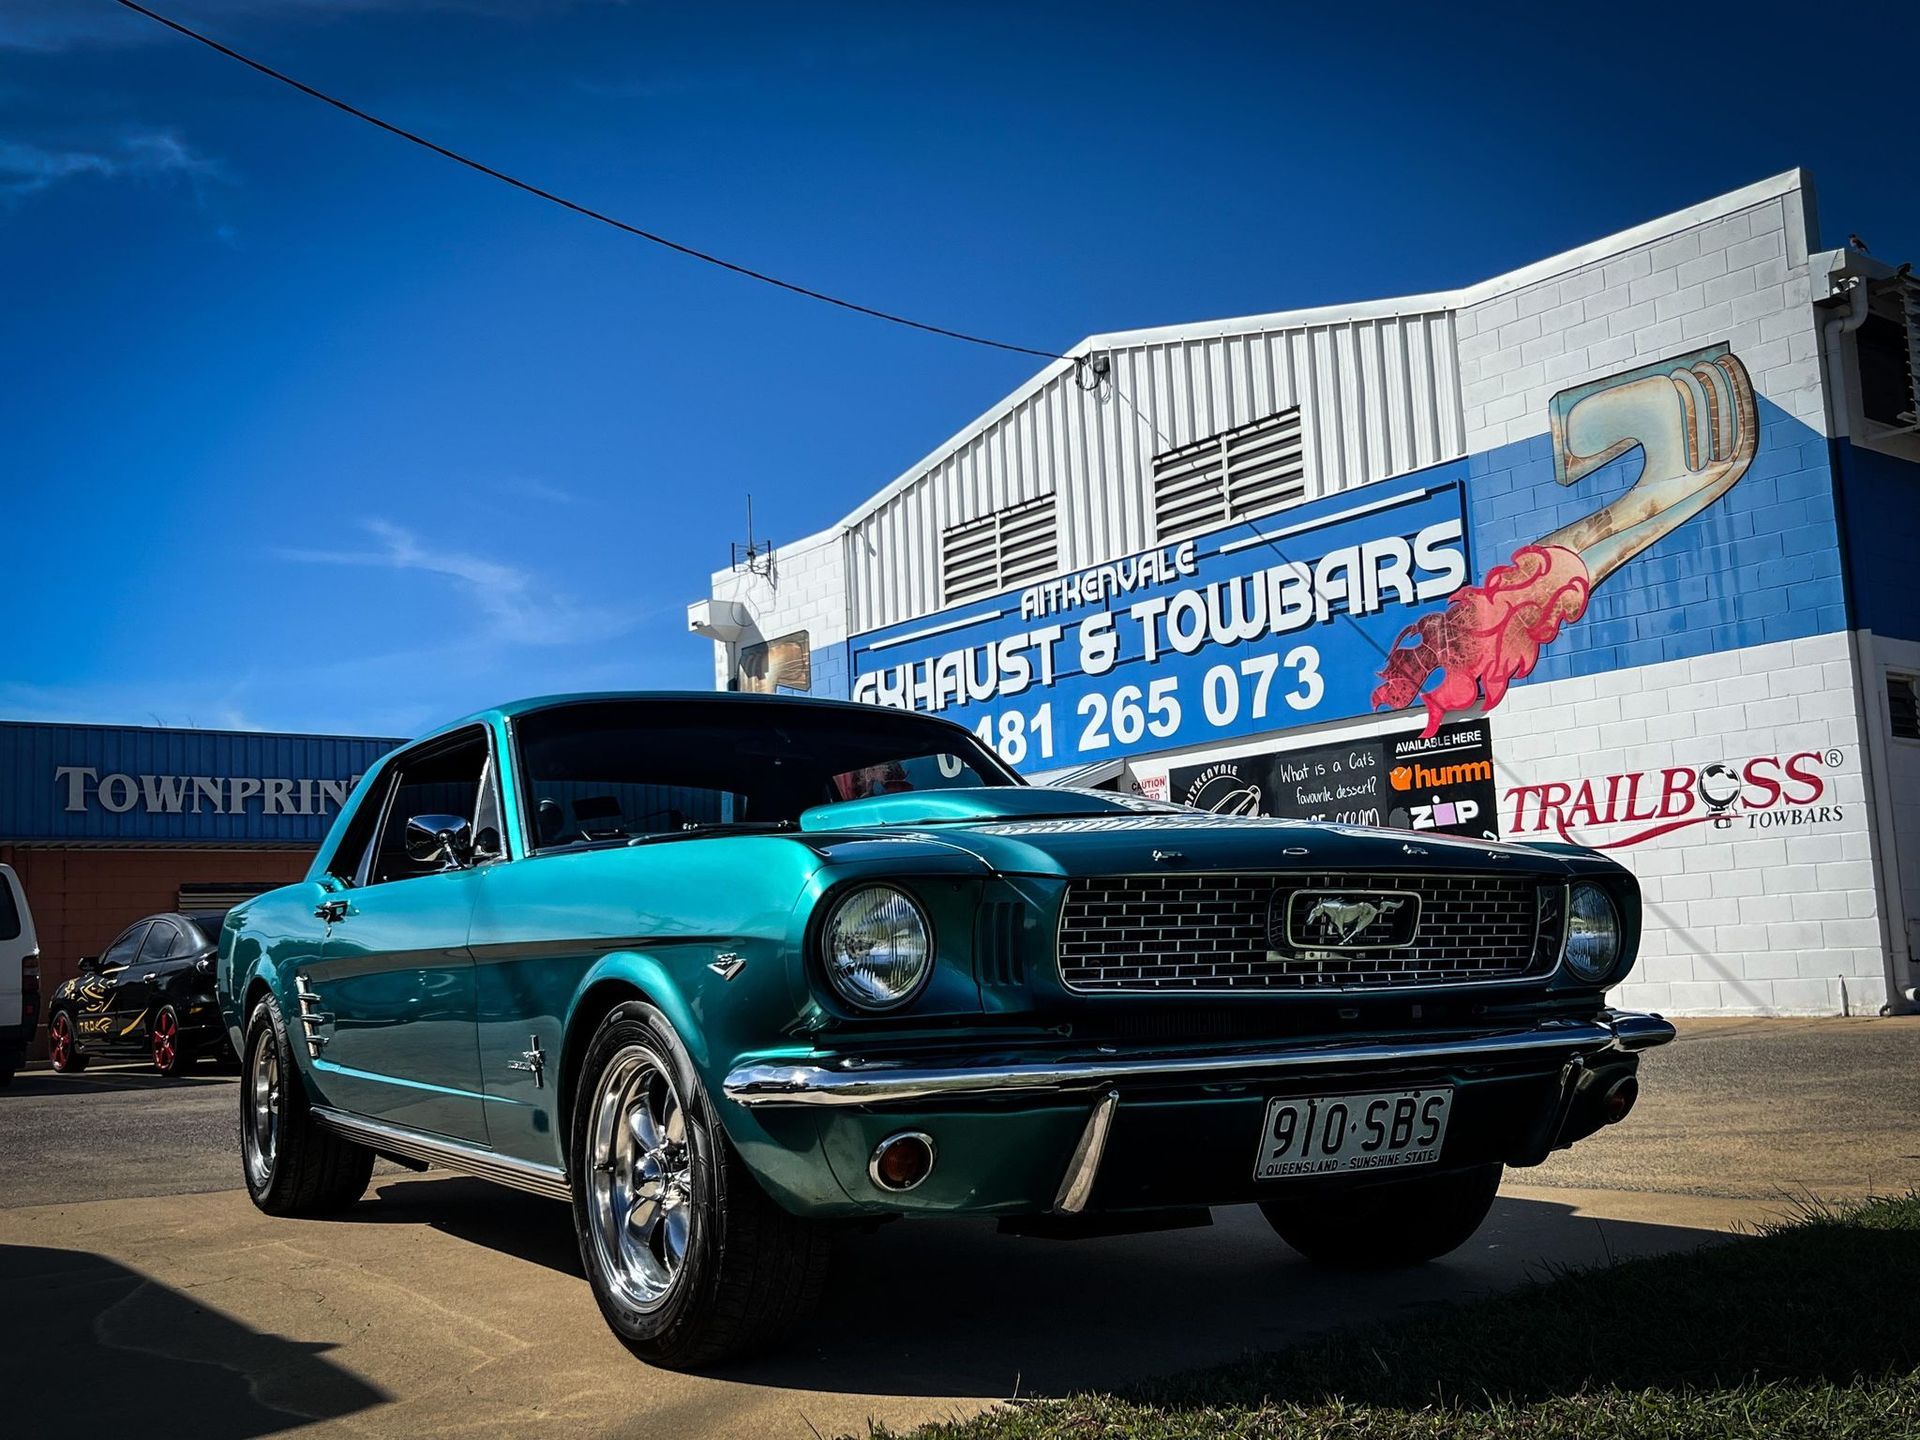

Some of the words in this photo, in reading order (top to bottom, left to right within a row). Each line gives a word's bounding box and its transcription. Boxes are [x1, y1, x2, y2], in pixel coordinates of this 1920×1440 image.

[1021, 540, 1195, 621] AITKENVALE
[852, 624, 1062, 712] EXHAUST
[1079, 611, 1117, 675] &
[1131, 518, 1466, 662] TOWBARS
[1076, 675, 1182, 752] 265
[1202, 645, 1325, 727] 073
[1395, 734, 1451, 753] AVAILABLE
[1452, 730, 1483, 745] HERE
[1131, 778, 1166, 791] CAUTION
[1280, 763, 1310, 783] What
[1315, 764, 1326, 776] is
[1333, 761, 1342, 772] a
[1414, 760, 1491, 789] humm
[1747, 806, 1844, 830] TOWBARS
[1265, 1158, 1339, 1177] QUEENSLAND
[1349, 1152, 1400, 1169] SUNSHINE
[1404, 1150, 1435, 1164] STATE
